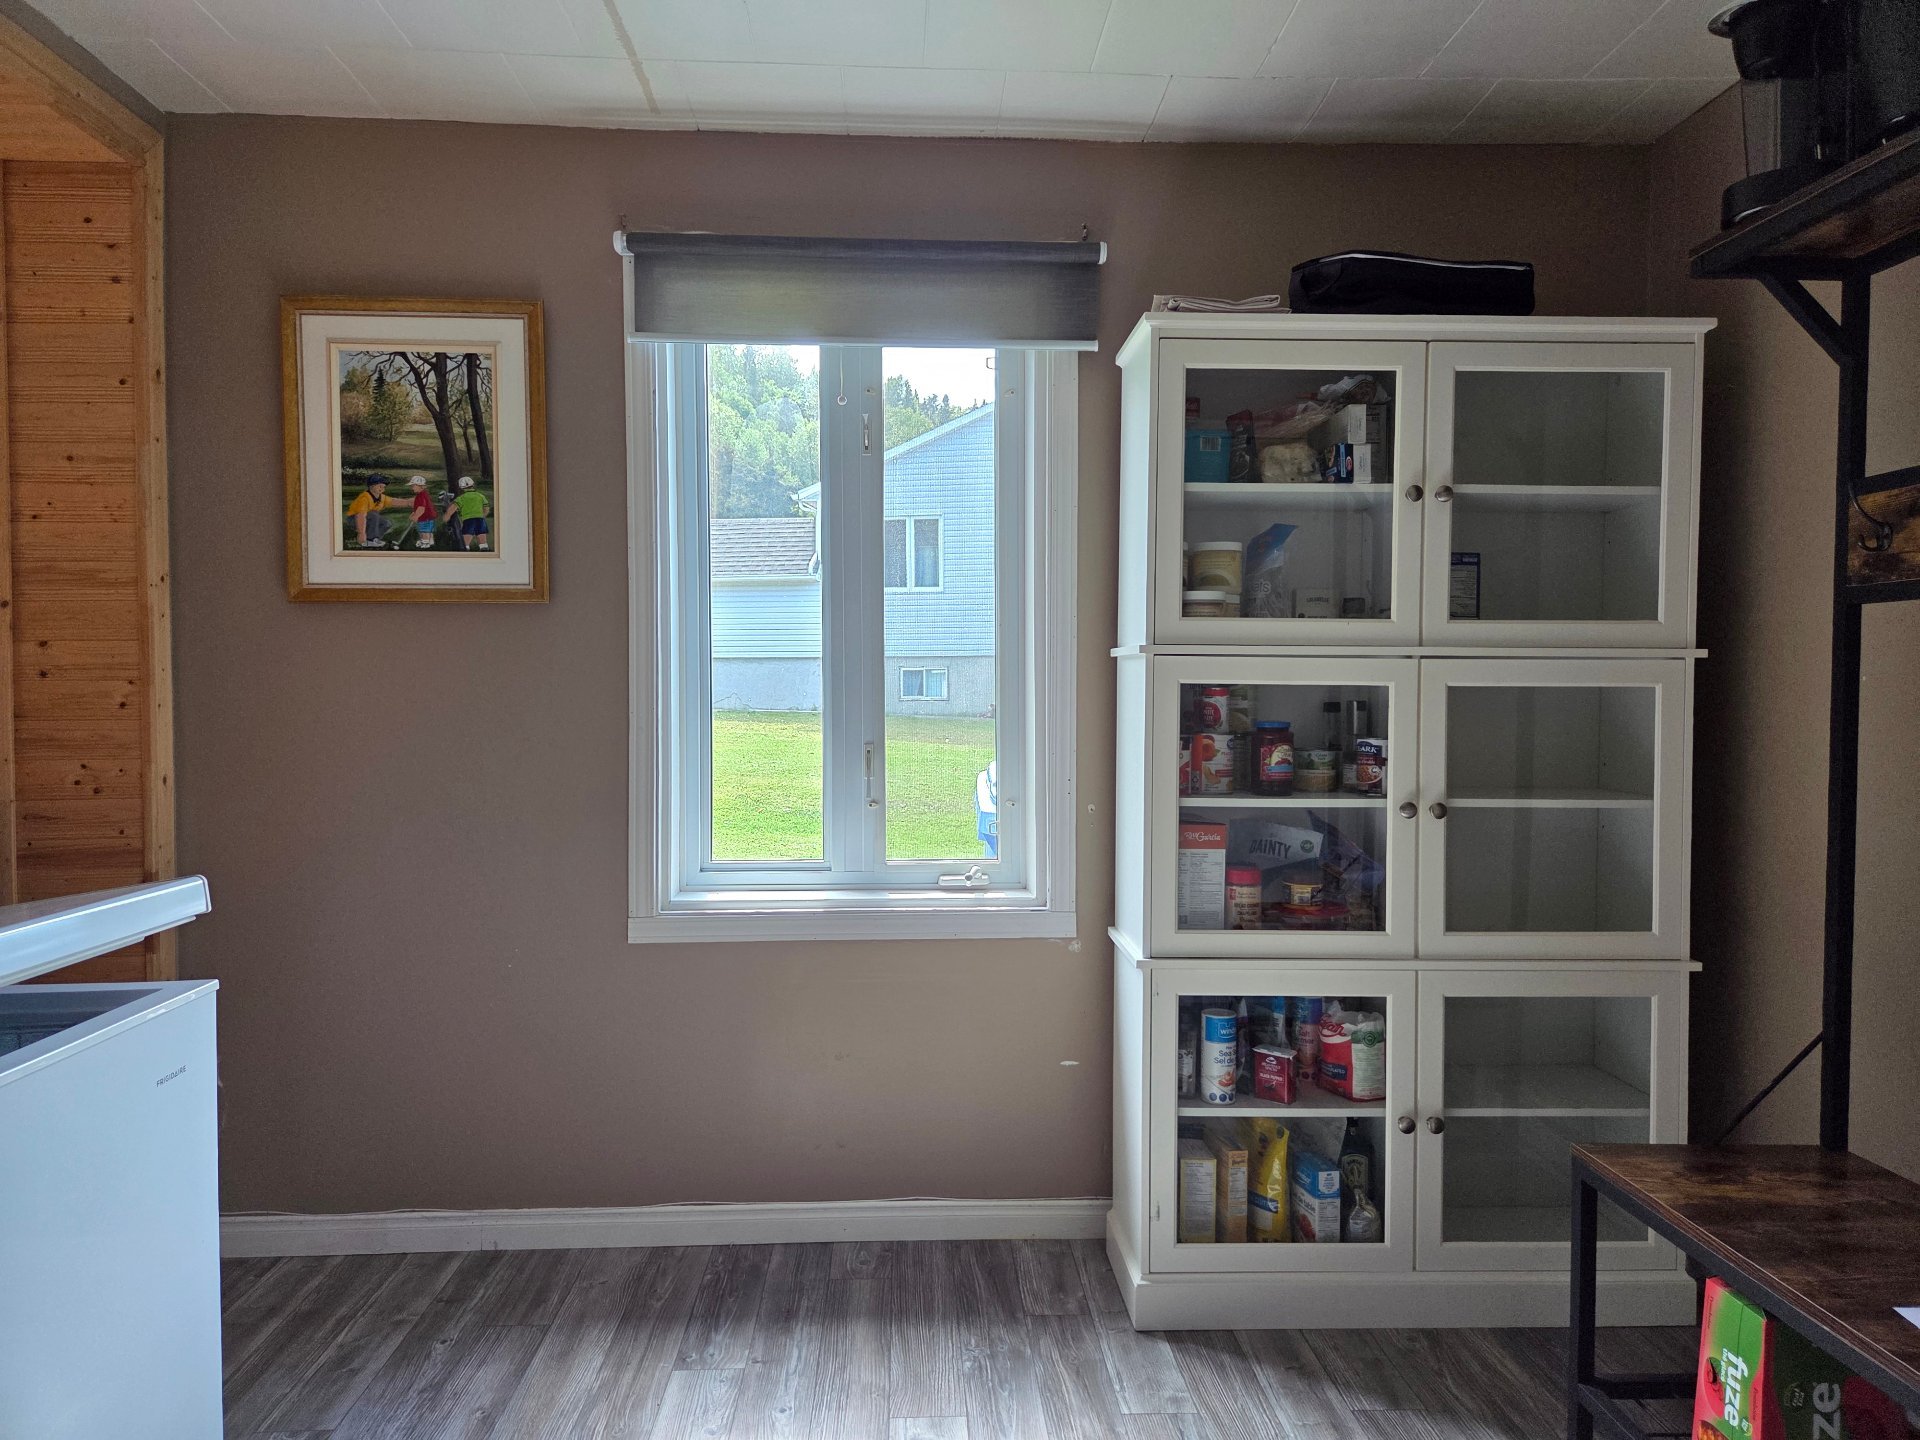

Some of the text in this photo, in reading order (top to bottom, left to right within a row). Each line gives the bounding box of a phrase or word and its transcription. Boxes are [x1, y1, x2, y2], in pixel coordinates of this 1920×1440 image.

[1249, 838, 1291, 859] DAINTY
[156, 1064, 187, 1088] FRIGIDAIRE
[1723, 1351, 1749, 1427] fuze
